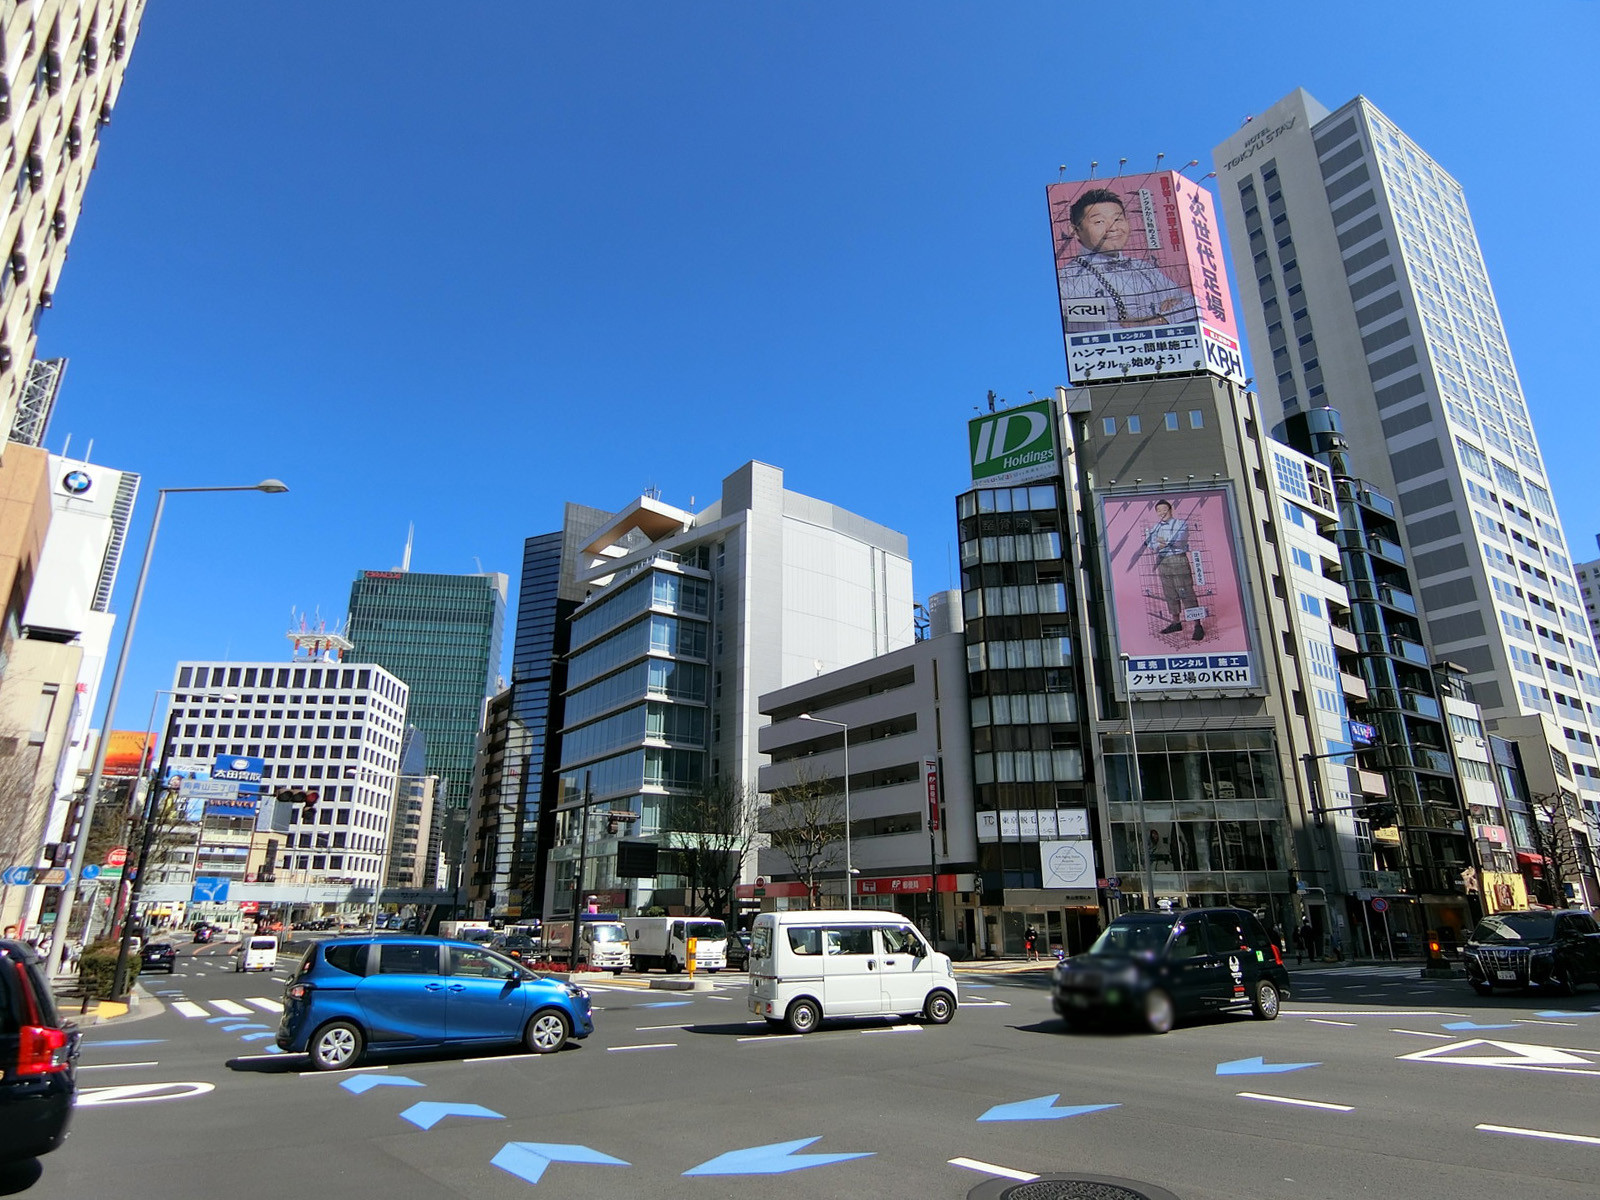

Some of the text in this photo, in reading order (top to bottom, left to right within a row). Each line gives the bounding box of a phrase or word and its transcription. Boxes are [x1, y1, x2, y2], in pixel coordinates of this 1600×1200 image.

[1223, 116, 1296, 171] TOKYU STAY
[1244, 127, 1271, 148] HOTEL
[1187, 192, 1226, 323] 次世代足場
[1068, 305, 1106, 316] KRH
[1120, 332, 1146, 340] レンタル
[1205, 339, 1243, 378] KRH
[1003, 448, 1054, 469] Holdings
[1136, 657, 1240, 669] 販売 レンタル 施工
[1133, 670, 1247, 685] クサビ足場のKRH
